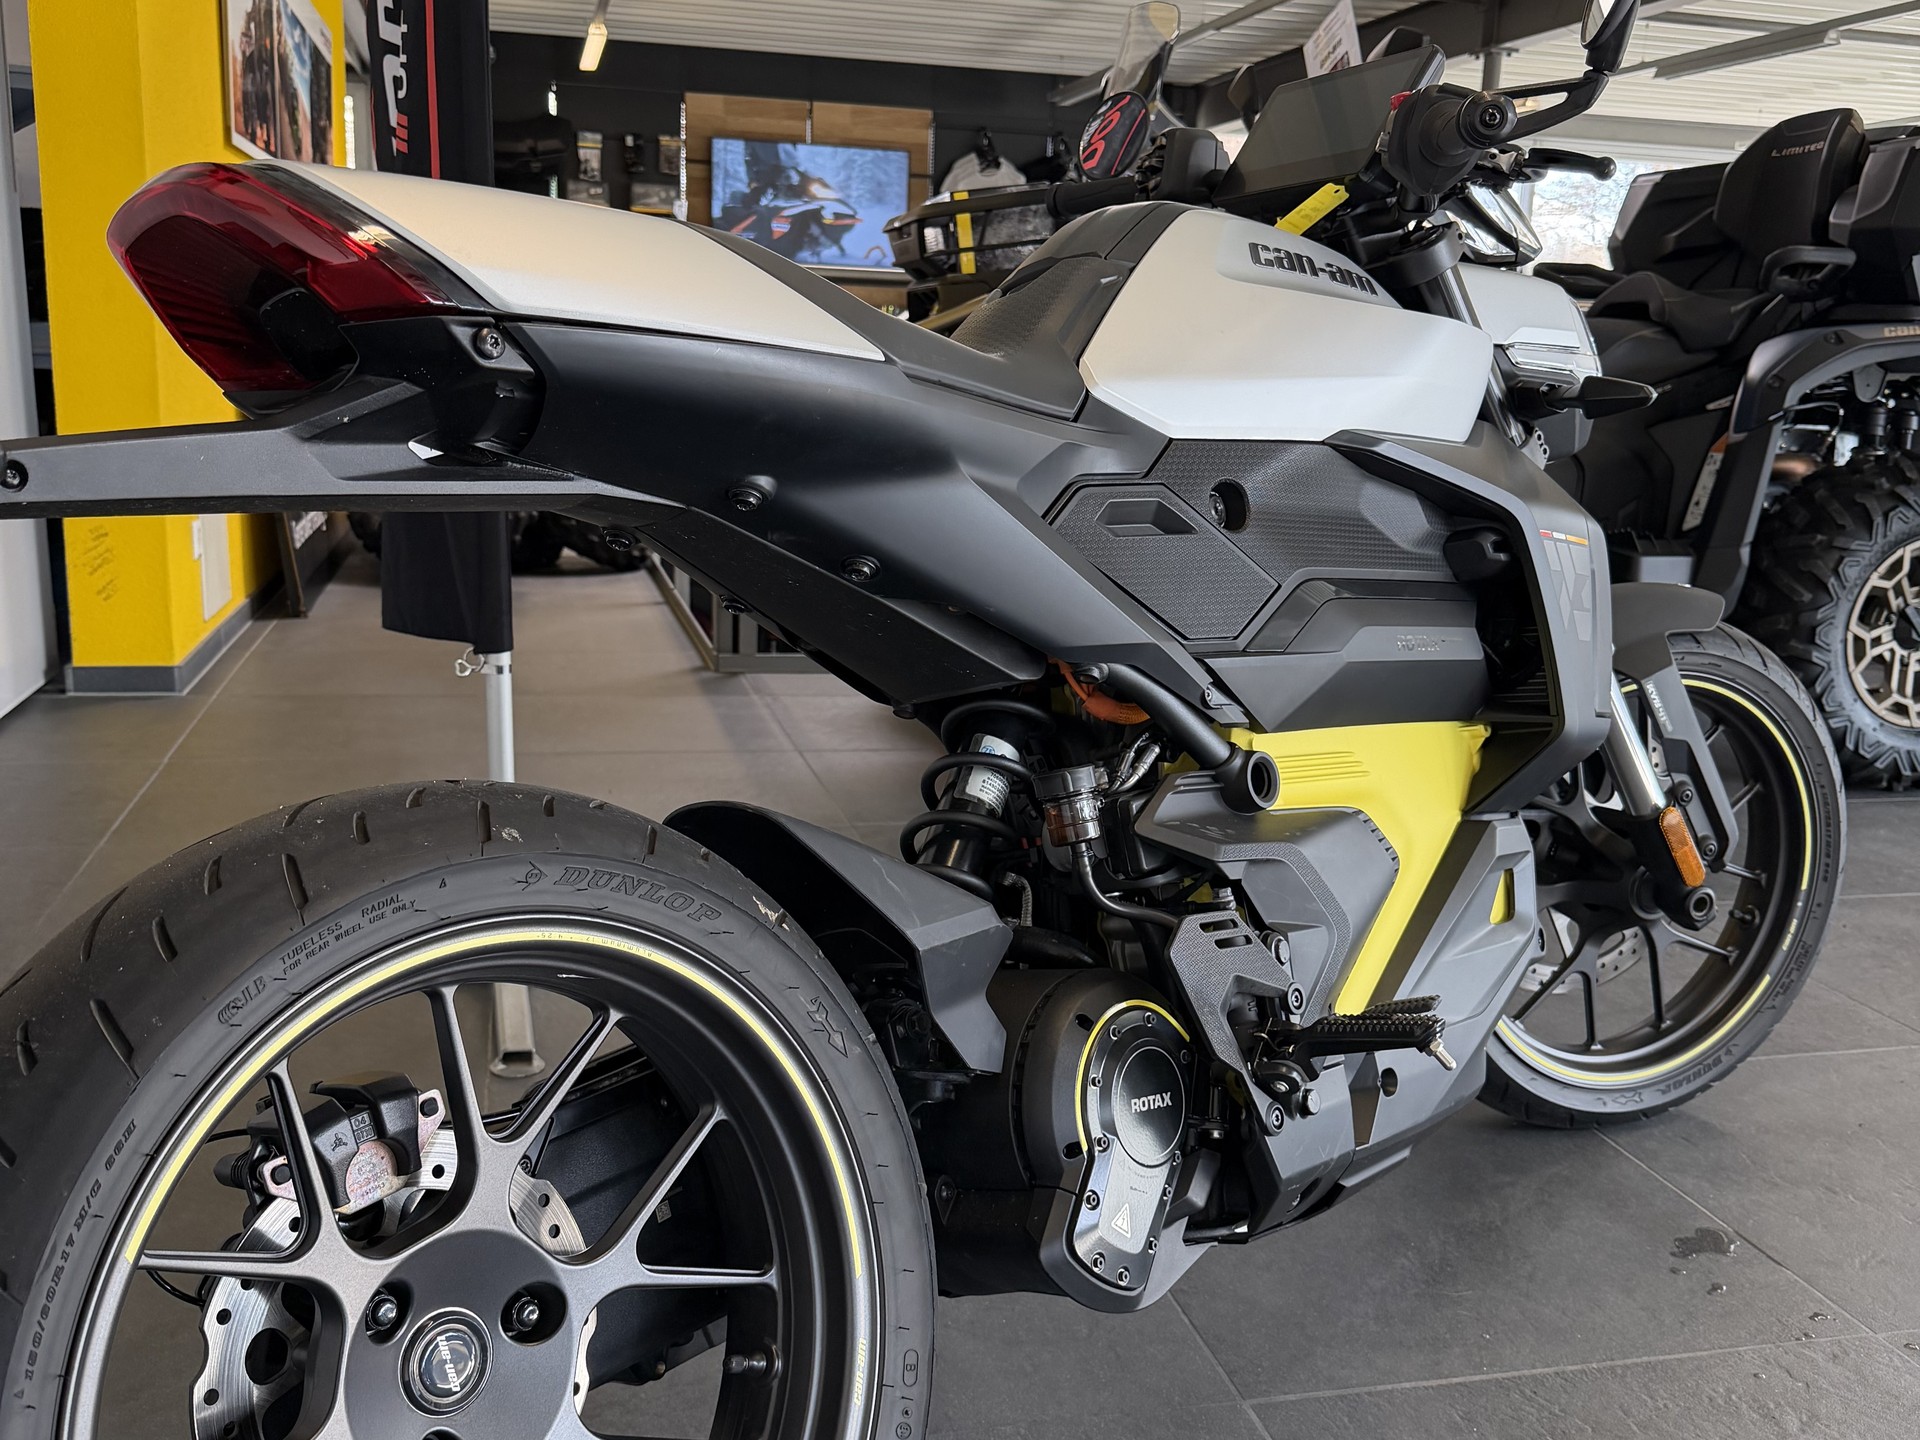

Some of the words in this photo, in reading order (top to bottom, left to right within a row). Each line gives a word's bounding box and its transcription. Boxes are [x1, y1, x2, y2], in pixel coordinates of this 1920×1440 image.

[1248, 242, 1378, 296] can-am
[554, 866, 722, 922] DUNLOP
[279, 920, 343, 965] TUBELESS
[361, 893, 404, 918] RADIAL
[283, 959, 301, 976] FOR
[305, 940, 330, 960] REAR
[335, 922, 365, 942] WHEEL
[369, 911, 387, 924] USE
[392, 899, 416, 915] ONLY
[1131, 1091, 1172, 1114] ROTAX
[1661, 1054, 1723, 1095] DUNLOP
[24, 1237, 76, 1381] 150/60R17
[74, 1179, 102, 1232] M/C
[104, 1118, 137, 1172] 66H
[437, 1336, 461, 1392] can-am
[853, 1337, 867, 1407] can-am
